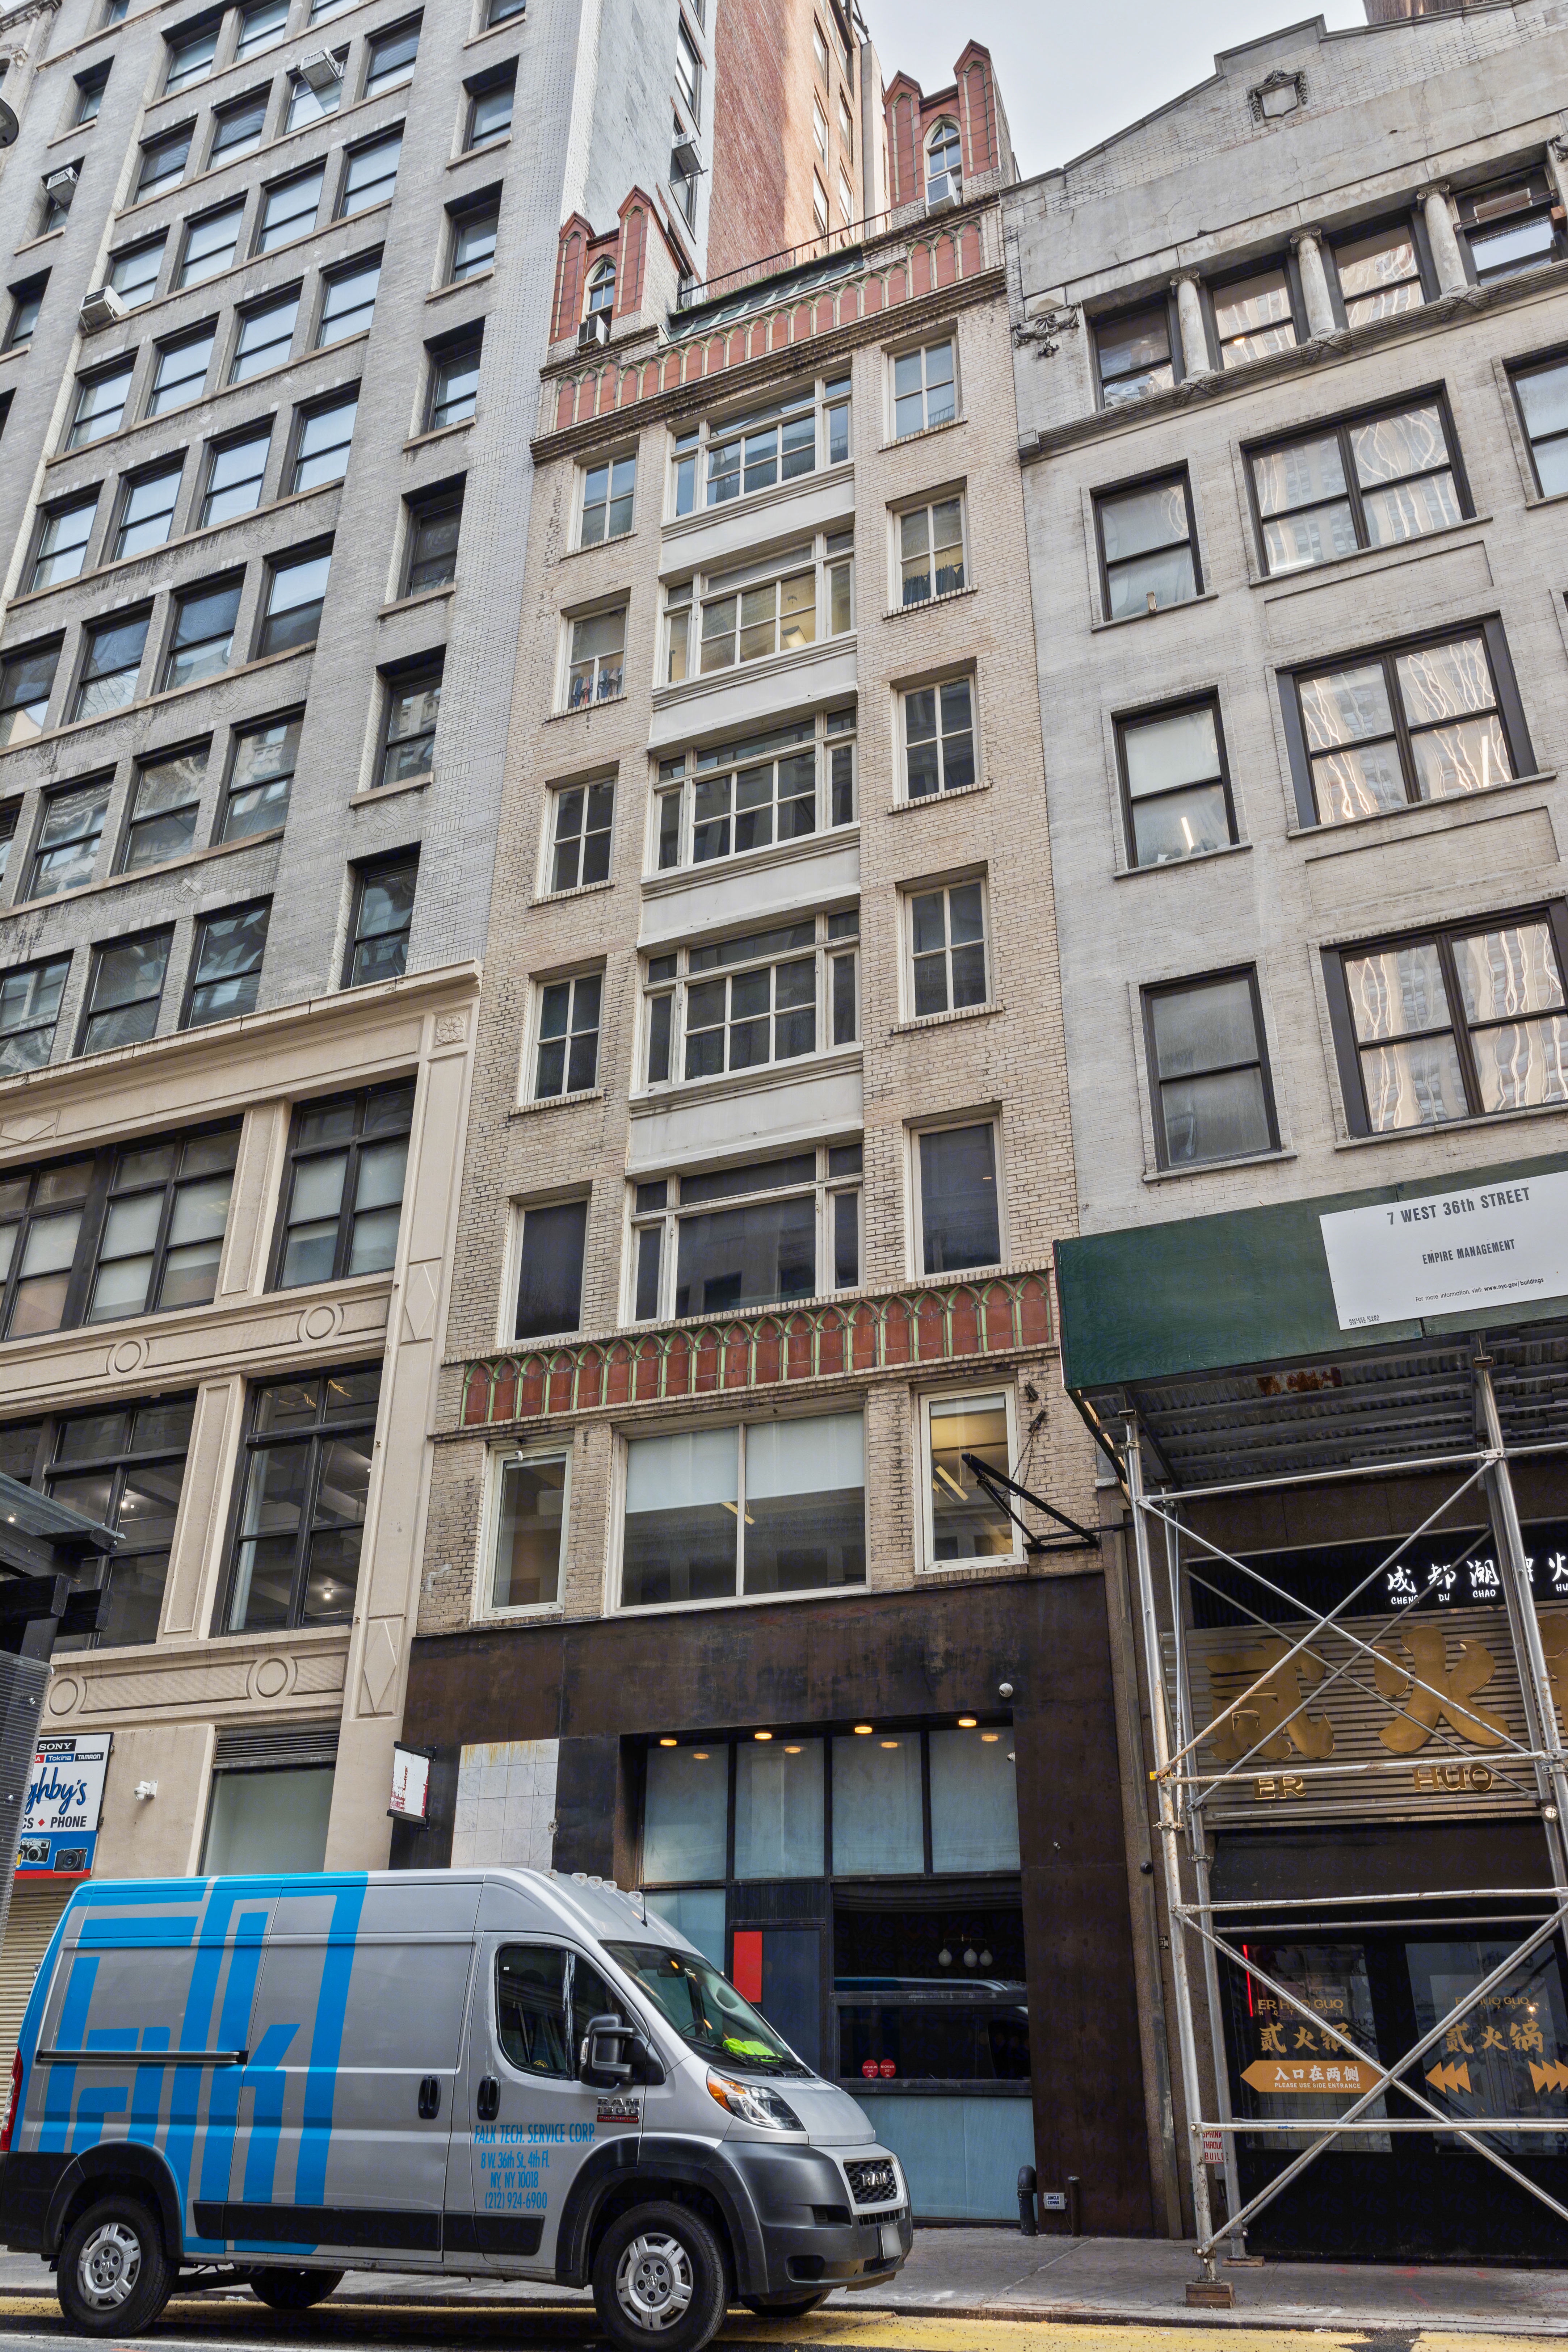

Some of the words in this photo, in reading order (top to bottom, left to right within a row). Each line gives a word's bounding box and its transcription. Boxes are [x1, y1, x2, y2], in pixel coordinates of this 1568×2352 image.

[1387, 1212, 1394, 1225] 7
[1400, 1205, 1436, 1223] WEST
[1443, 1198, 1475, 1216] 36th
[1480, 1187, 1530, 1209] STREET
[1422, 1250, 1454, 1264] EMPIRE
[1456, 1239, 1515, 1259] MANAGEMENT
[1440, 1289, 1471, 1298] information,
[1484, 1277, 1544, 1292] www.nyc.gov/buildings
[1438, 1593, 1450, 1602] DU
[1472, 1589, 1496, 1598] CHAO
[39, 1742, 72, 1751] SONY
[1253, 1775, 1306, 1799] ER
[1412, 1763, 1492, 1792] HUO
[50, 1816, 87, 1828] PHONE
[1258, 1999, 1277, 2009] ER
[1314, 1999, 1344, 2009] GUO
[1446, 2021, 1543, 2054] 贰火锅
[1274, 2065, 1359, 2082] 入口在两侧
[597, 2097, 640, 2107] RAM
[597, 2105, 640, 2114] 1500
[474, 2125, 497, 2144] FALK
[500, 2124, 524, 2143] TECH.
[527, 2124, 565, 2143] SERVICE
[569, 2123, 595, 2143] CORP.
[481, 2152, 486, 2169] 8
[488, 2152, 496, 2169] W.
[497, 2150, 514, 2168] 36th
[527, 2150, 540, 2168] 4th
[1205, 2152, 1223, 2160] BUIL
[504, 2172, 516, 2188] NY
[518, 2171, 539, 2188] 10018
[485, 2192, 505, 2209] (212)
[507, 2192, 547, 2209] 924-6900
